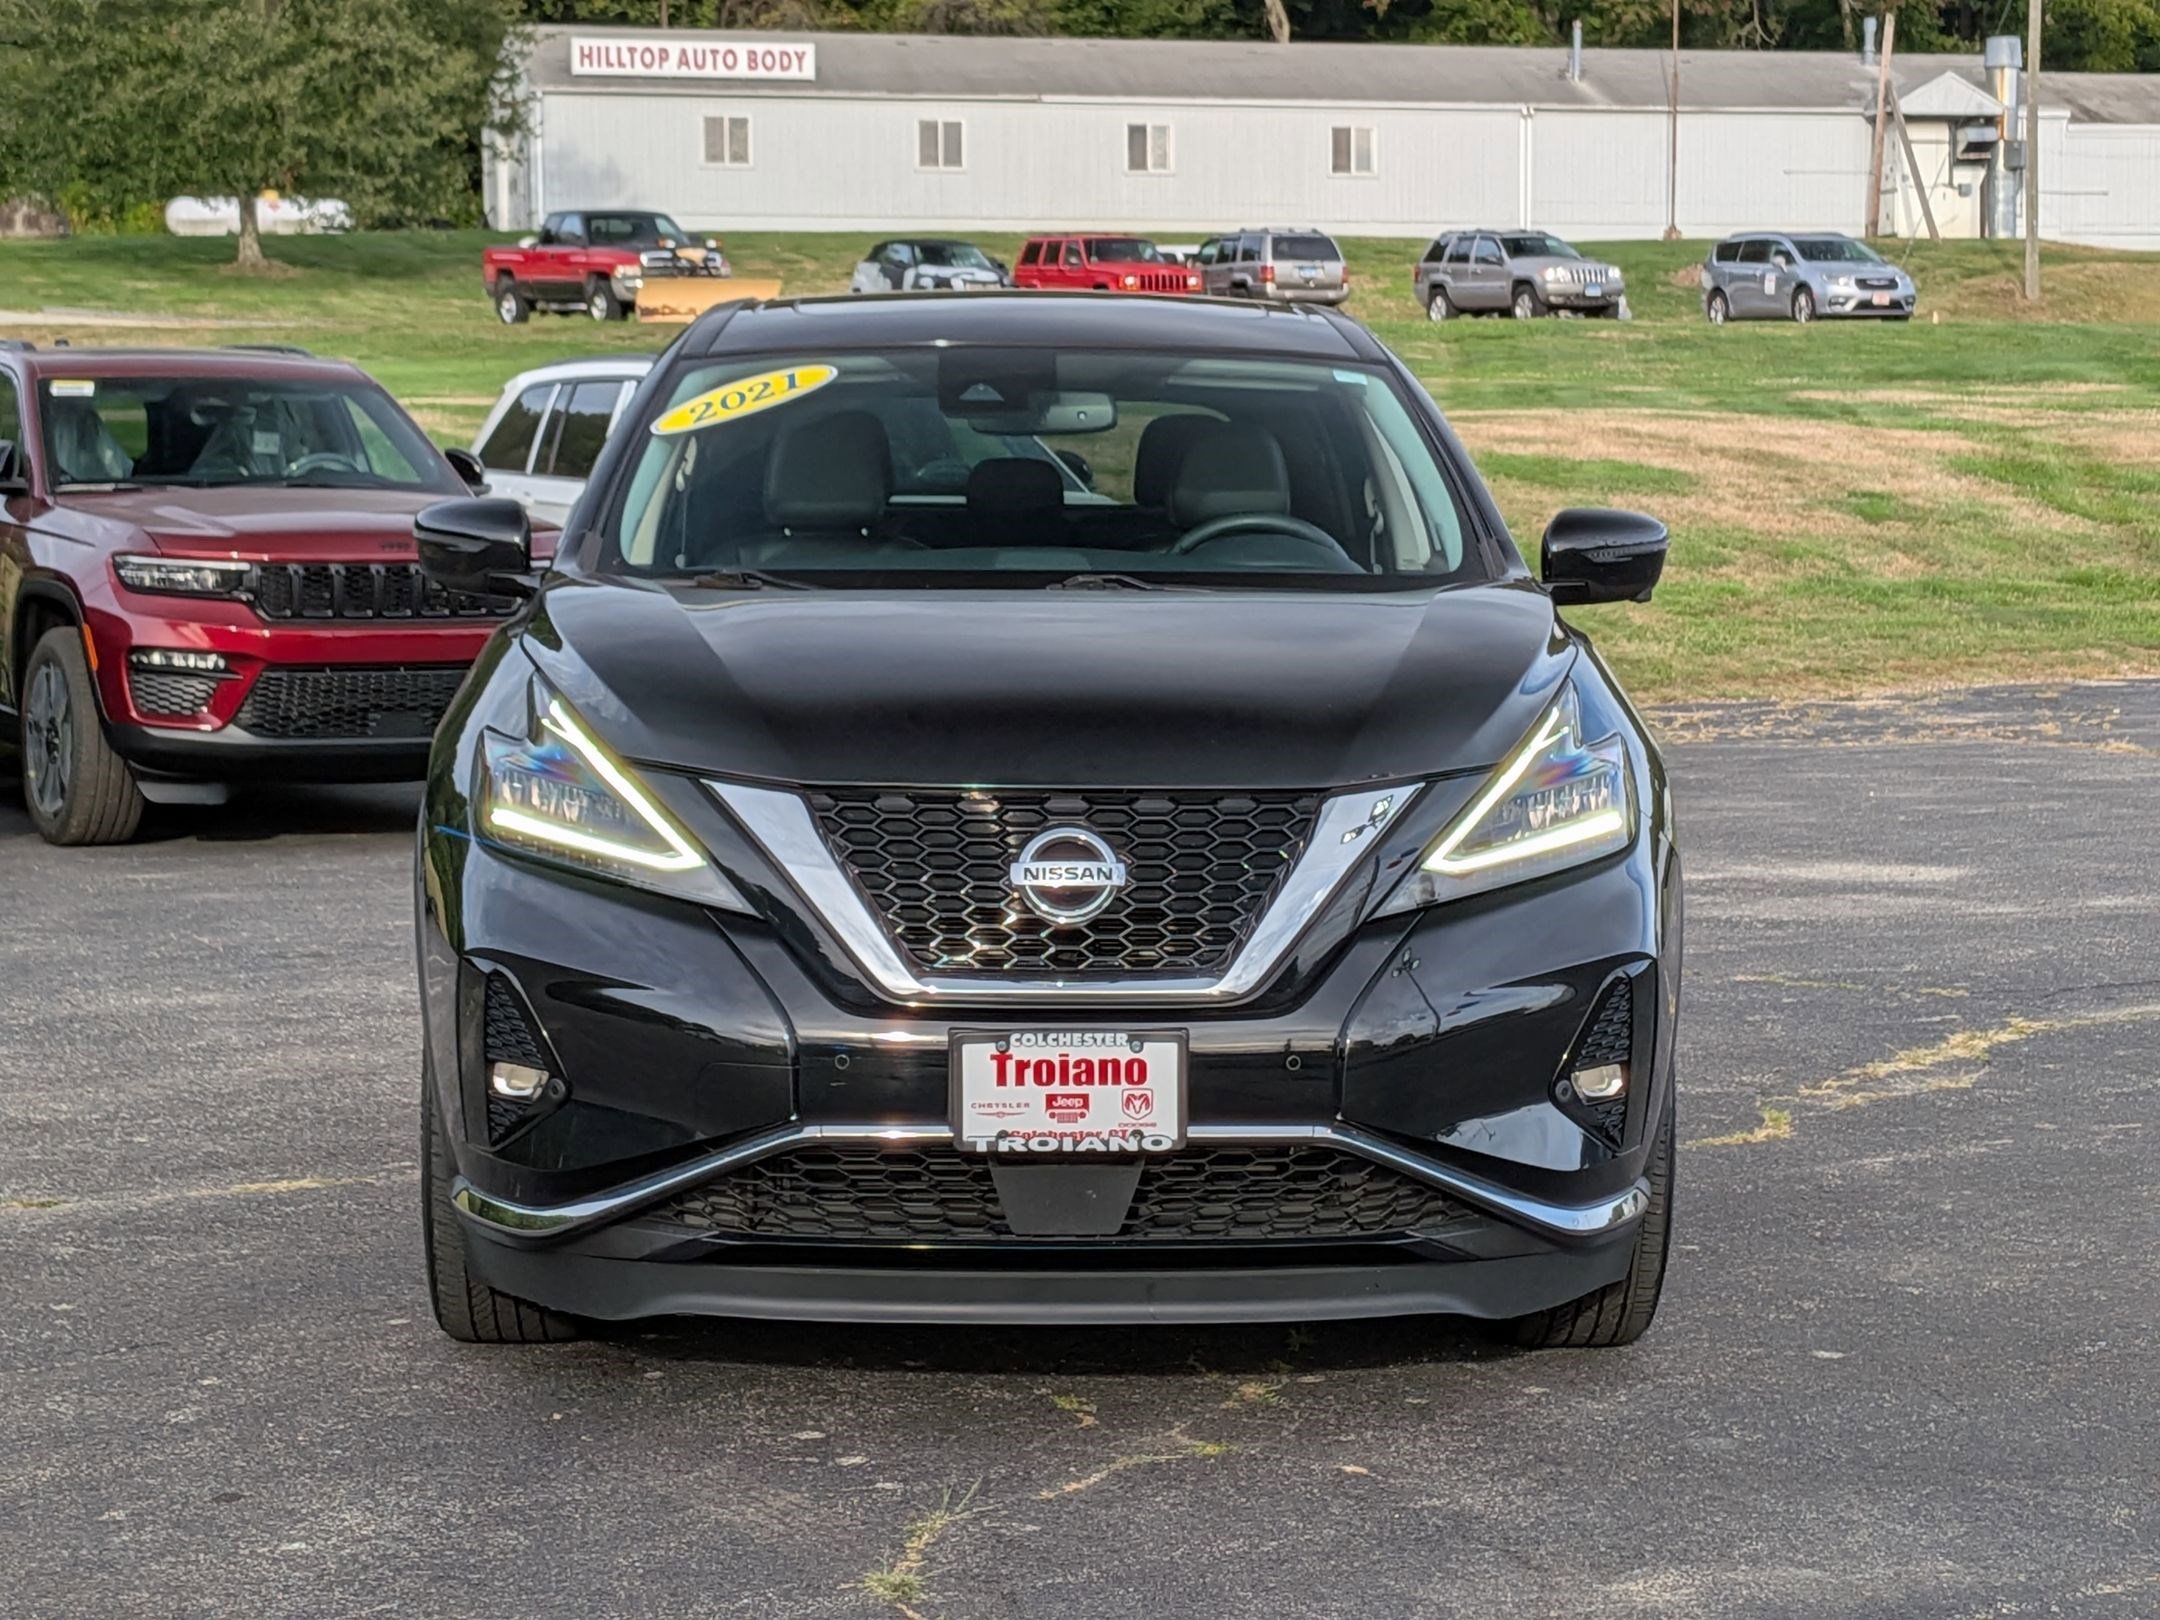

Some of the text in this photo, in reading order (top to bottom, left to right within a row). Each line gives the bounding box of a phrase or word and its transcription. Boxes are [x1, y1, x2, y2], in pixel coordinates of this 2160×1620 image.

[579, 45, 806, 72] HILLTOP AUTO BODY
[689, 373, 800, 424] 2021
[1023, 866, 1113, 881] NISSAN
[1009, 1033, 1129, 1047] COLCHESTER
[990, 1053, 1148, 1087] Troiano
[1052, 1096, 1084, 1108] Jeep
[968, 1135, 1173, 1152] TROIANO
